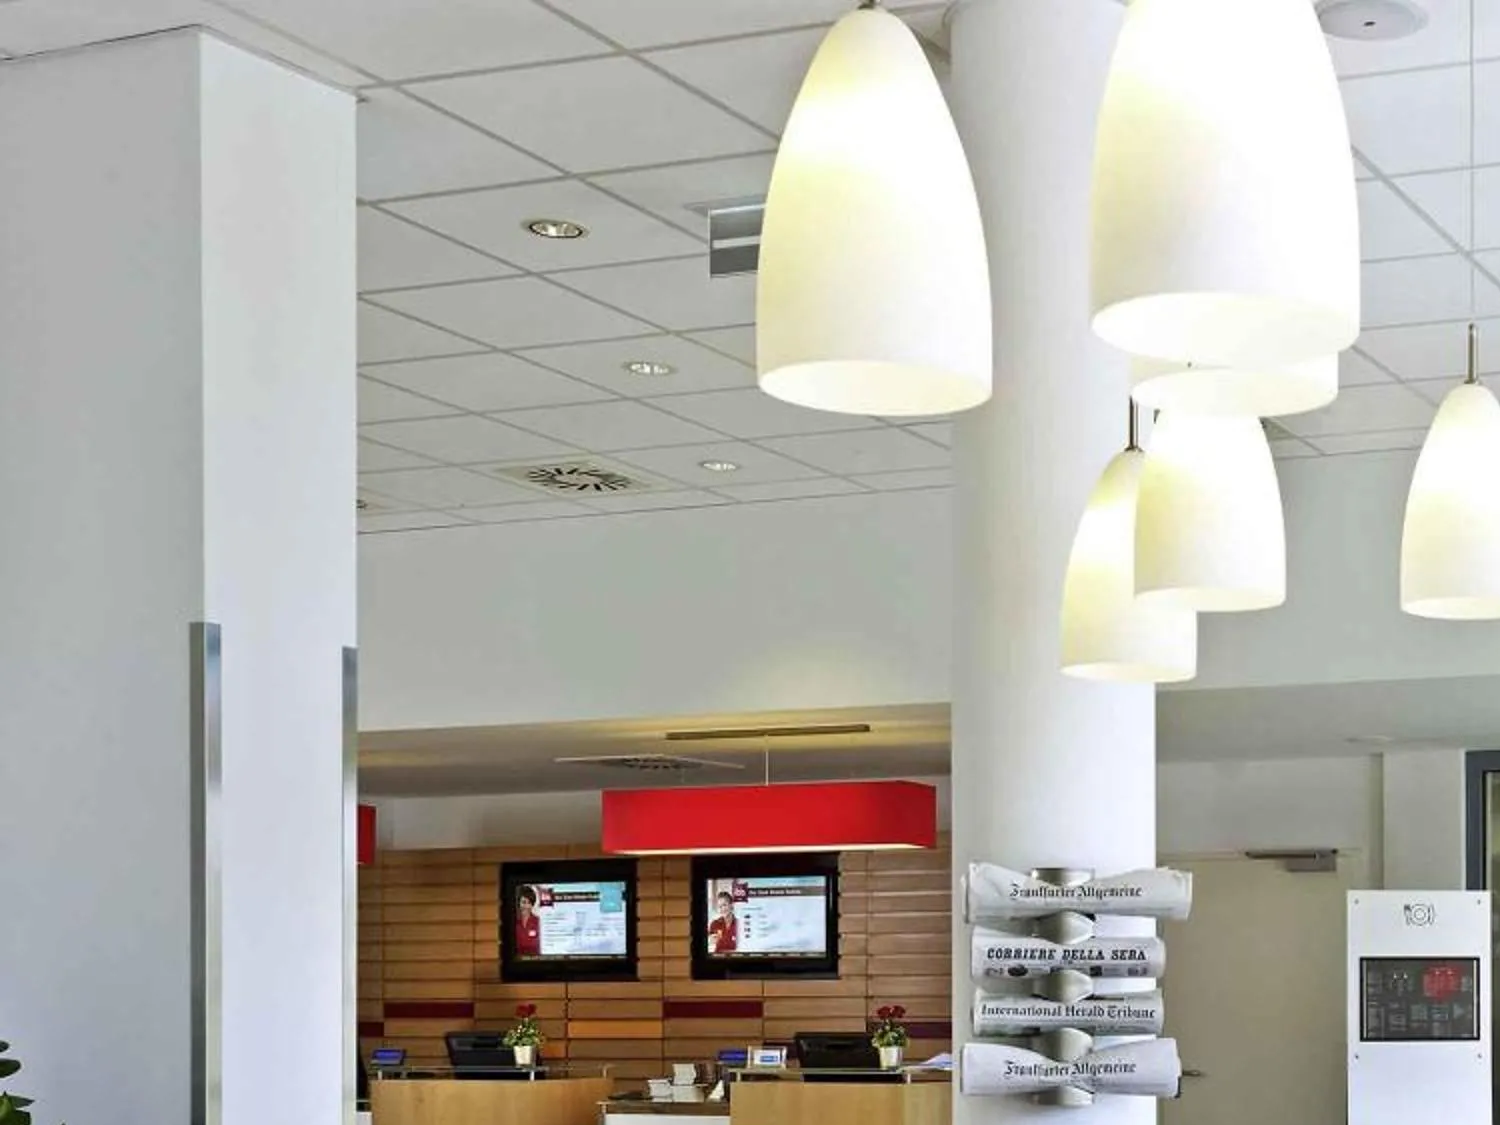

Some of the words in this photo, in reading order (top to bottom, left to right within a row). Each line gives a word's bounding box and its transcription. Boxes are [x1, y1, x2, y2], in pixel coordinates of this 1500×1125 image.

[1077, 884, 1143, 901] Allgemeine
[986, 948, 1056, 961] CORRIERE
[1061, 949, 1105, 961] DELLA
[1110, 949, 1147, 961] SERA
[981, 1003, 1061, 1017] International
[1064, 1004, 1105, 1018] Herald
[1106, 1005, 1156, 1019] Tribune
[1071, 1062, 1137, 1077] Allgemeine
